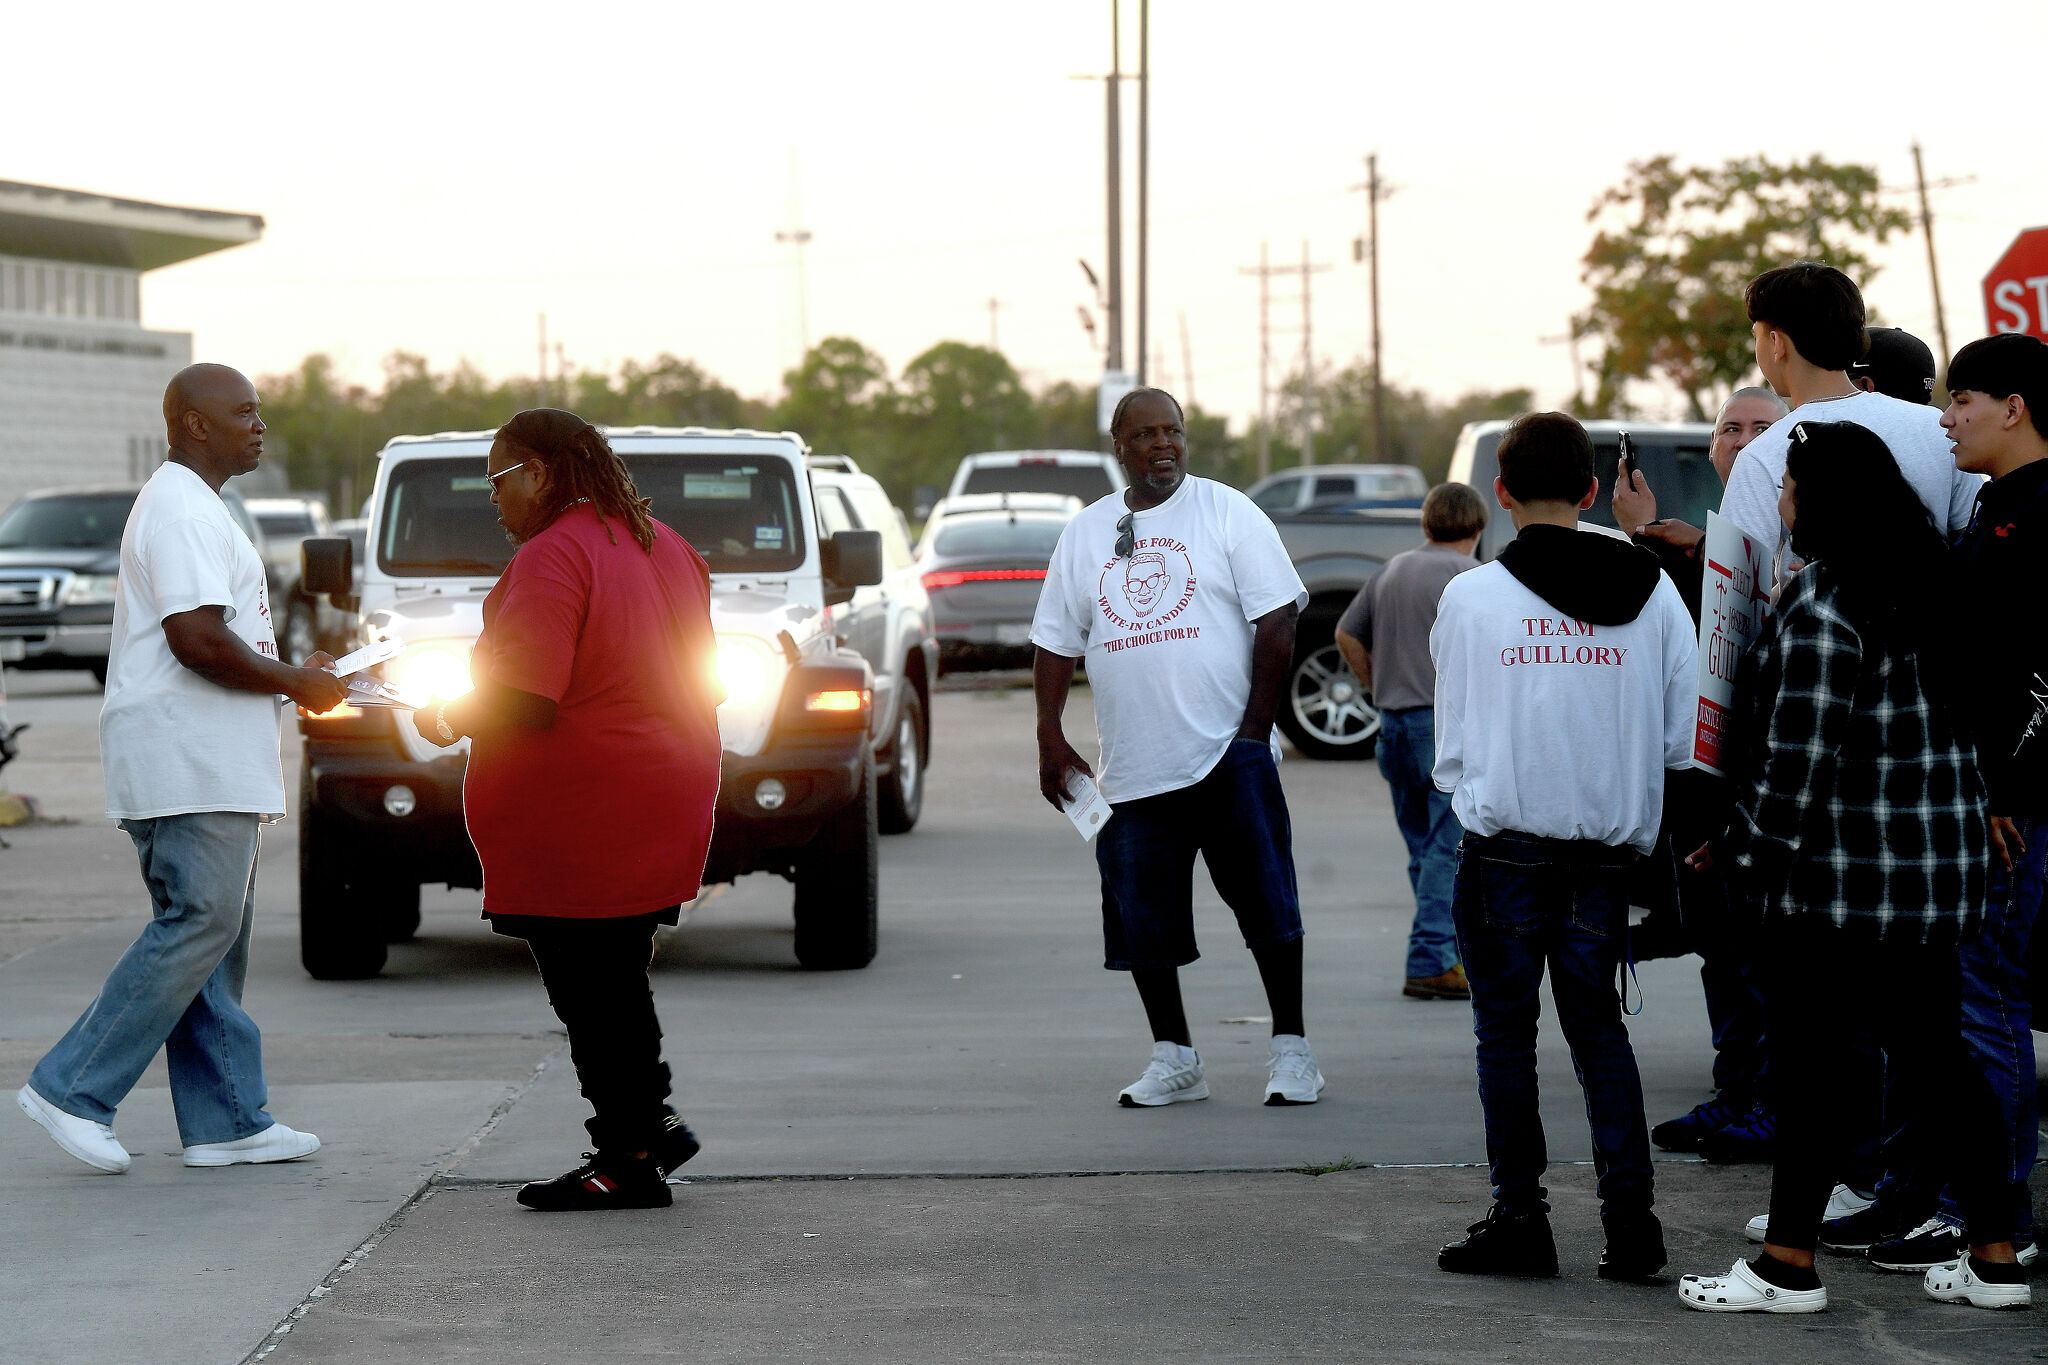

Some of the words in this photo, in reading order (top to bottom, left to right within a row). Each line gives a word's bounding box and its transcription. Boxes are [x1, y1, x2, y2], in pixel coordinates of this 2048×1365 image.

[1150, 538, 1175, 548] FOR
[1170, 542, 1187, 553] JP
[1732, 566, 1751, 599] ELECT
[1098, 595, 1144, 631] WRITE-IN
[1146, 577, 1197, 630] CANDIDATE
[1521, 618, 1595, 637] TEAM
[1727, 606, 1751, 639] JOSEPH
[1125, 631, 1163, 650] CHOICE
[1164, 628, 1186, 641] FOR
[1500, 646, 1628, 666] GUILLORY
